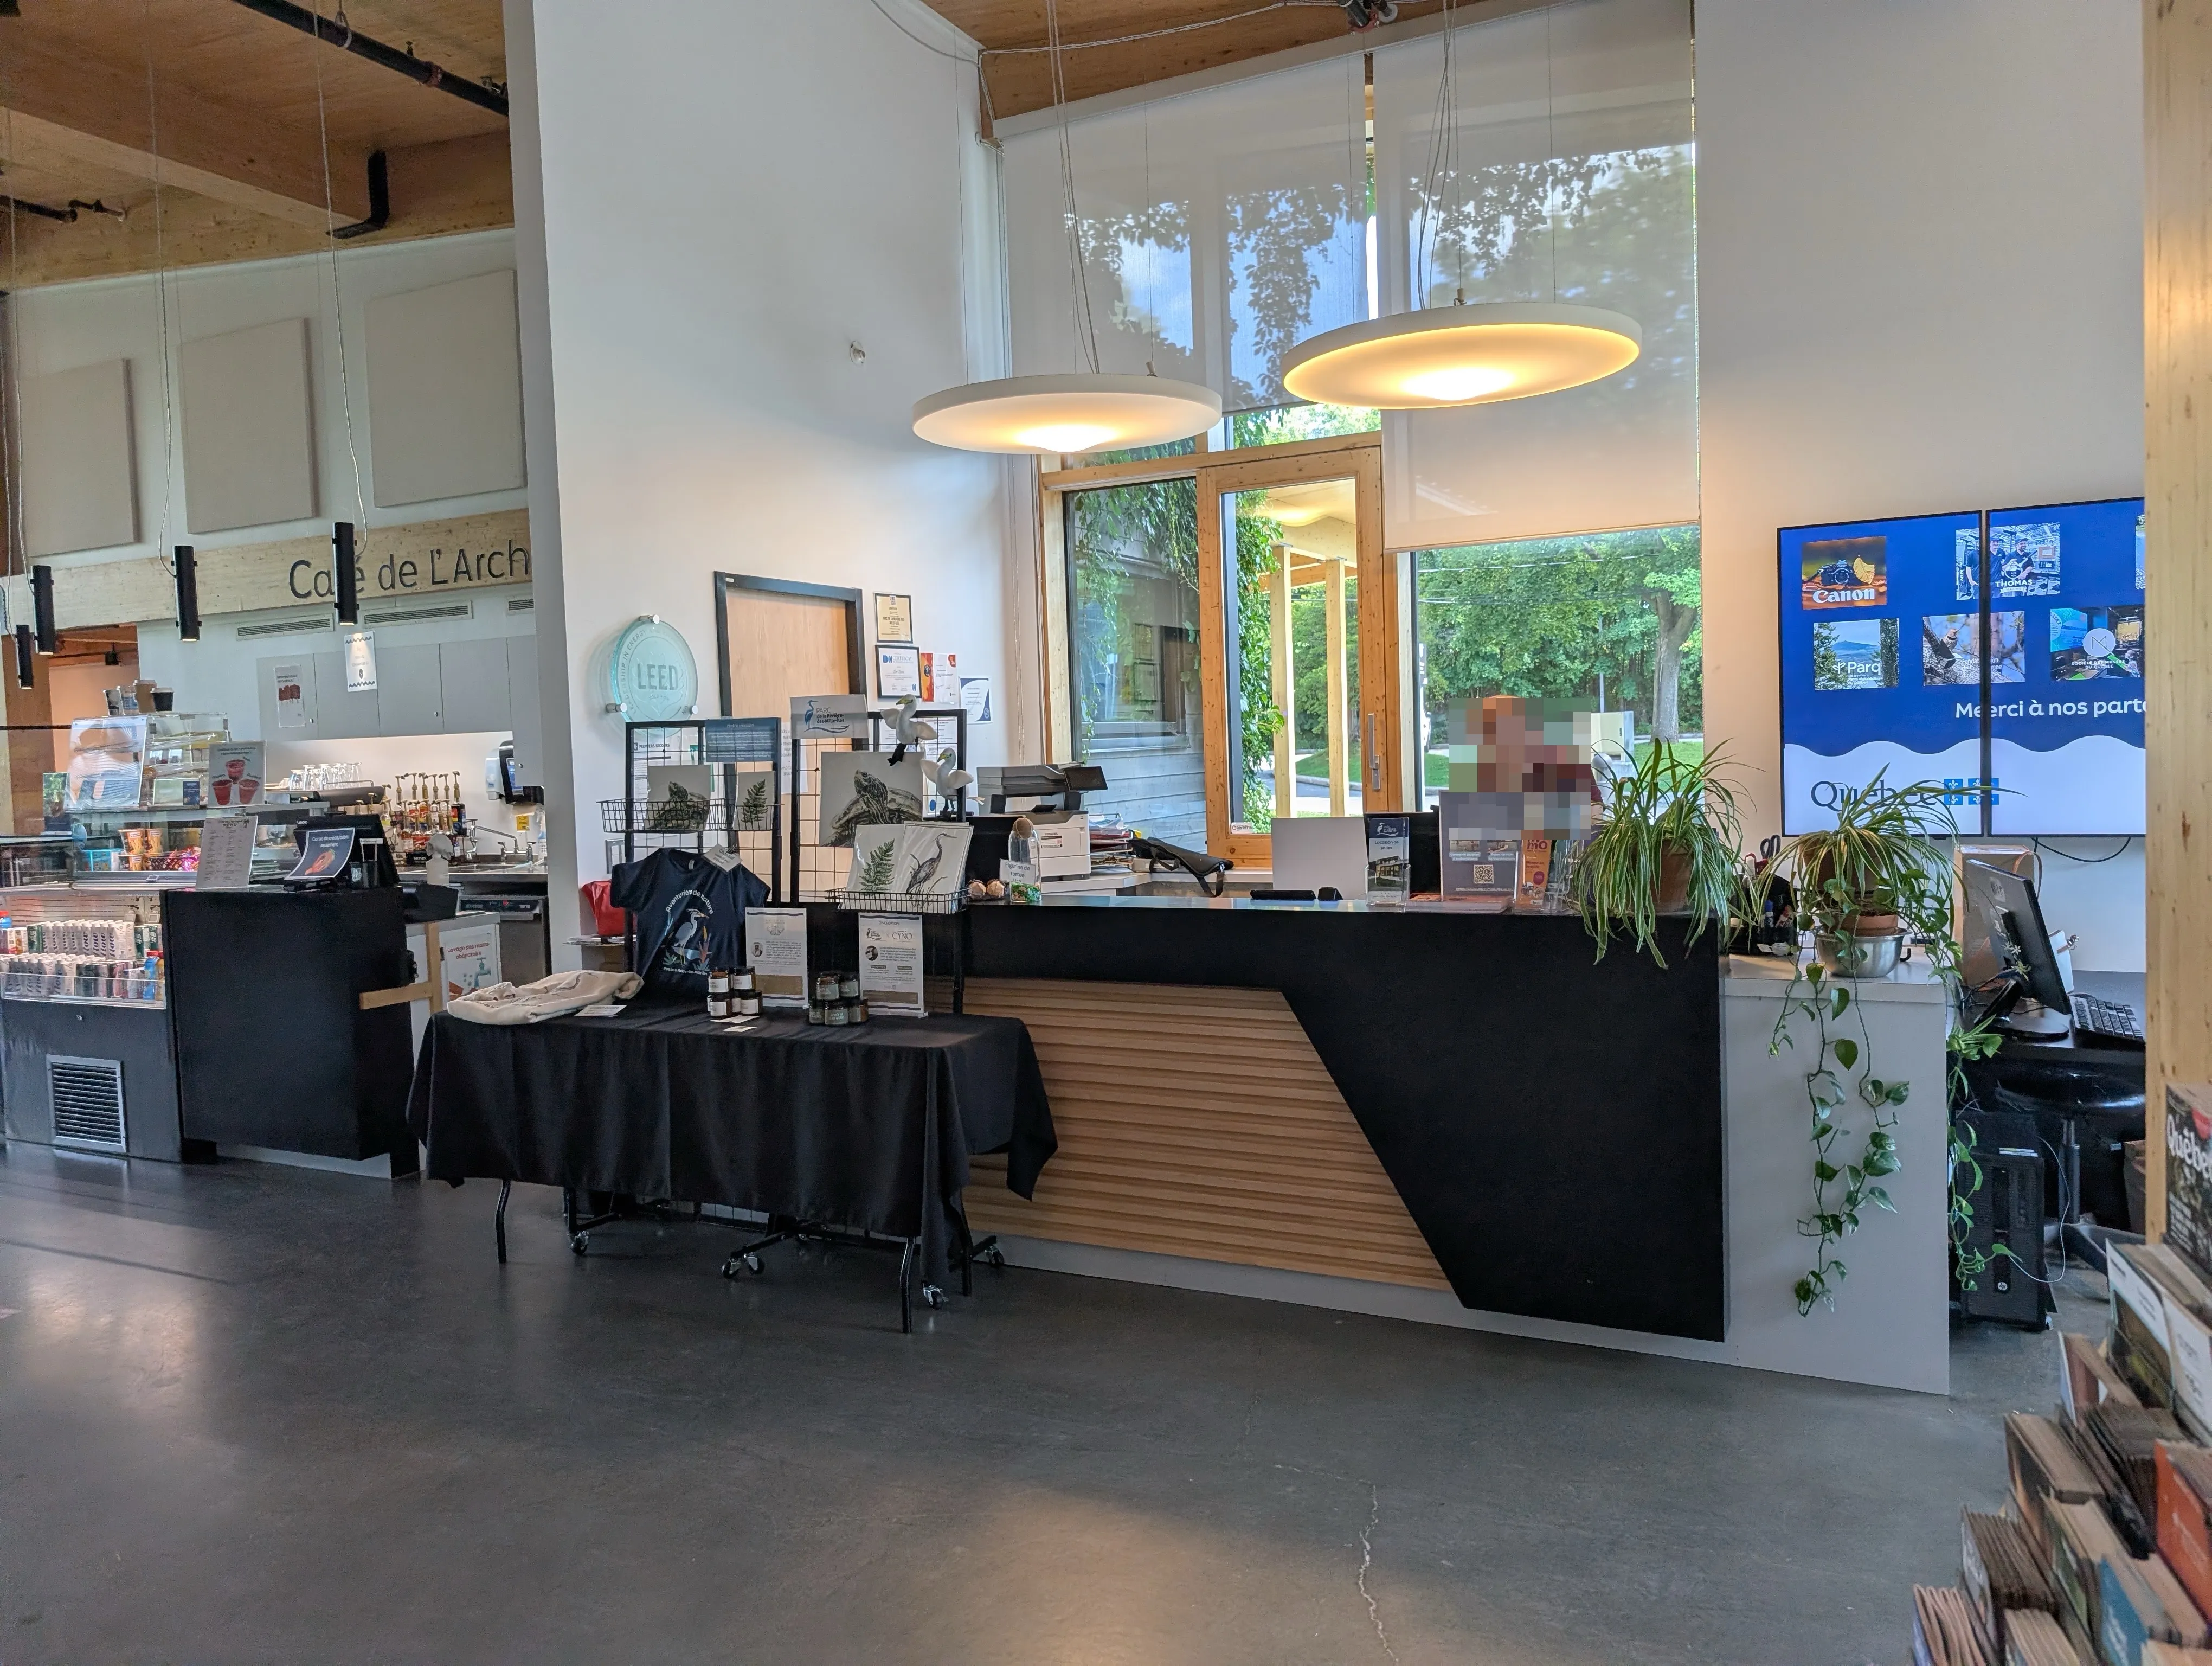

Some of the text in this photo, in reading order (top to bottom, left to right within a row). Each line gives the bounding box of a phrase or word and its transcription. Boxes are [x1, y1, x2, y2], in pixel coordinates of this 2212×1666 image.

[289, 555, 365, 599] Caé
[378, 553, 419, 591] de
[1995, 579, 2033, 587] THOMAS
[1812, 588, 1875, 603] Canon
[627, 630, 646, 650] ENERGY
[1848, 661, 1881, 676] Parq
[637, 663, 679, 691] LEED
[2029, 699, 2044, 716] à
[2049, 702, 2088, 716] nos
[1005, 862, 1024, 870] Figurine
[666, 889, 693, 913] Aventuriers
[700, 893, 713, 915] nature
[892, 932, 913, 940] CYNO
[455, 950, 482, 960] obligatoire
